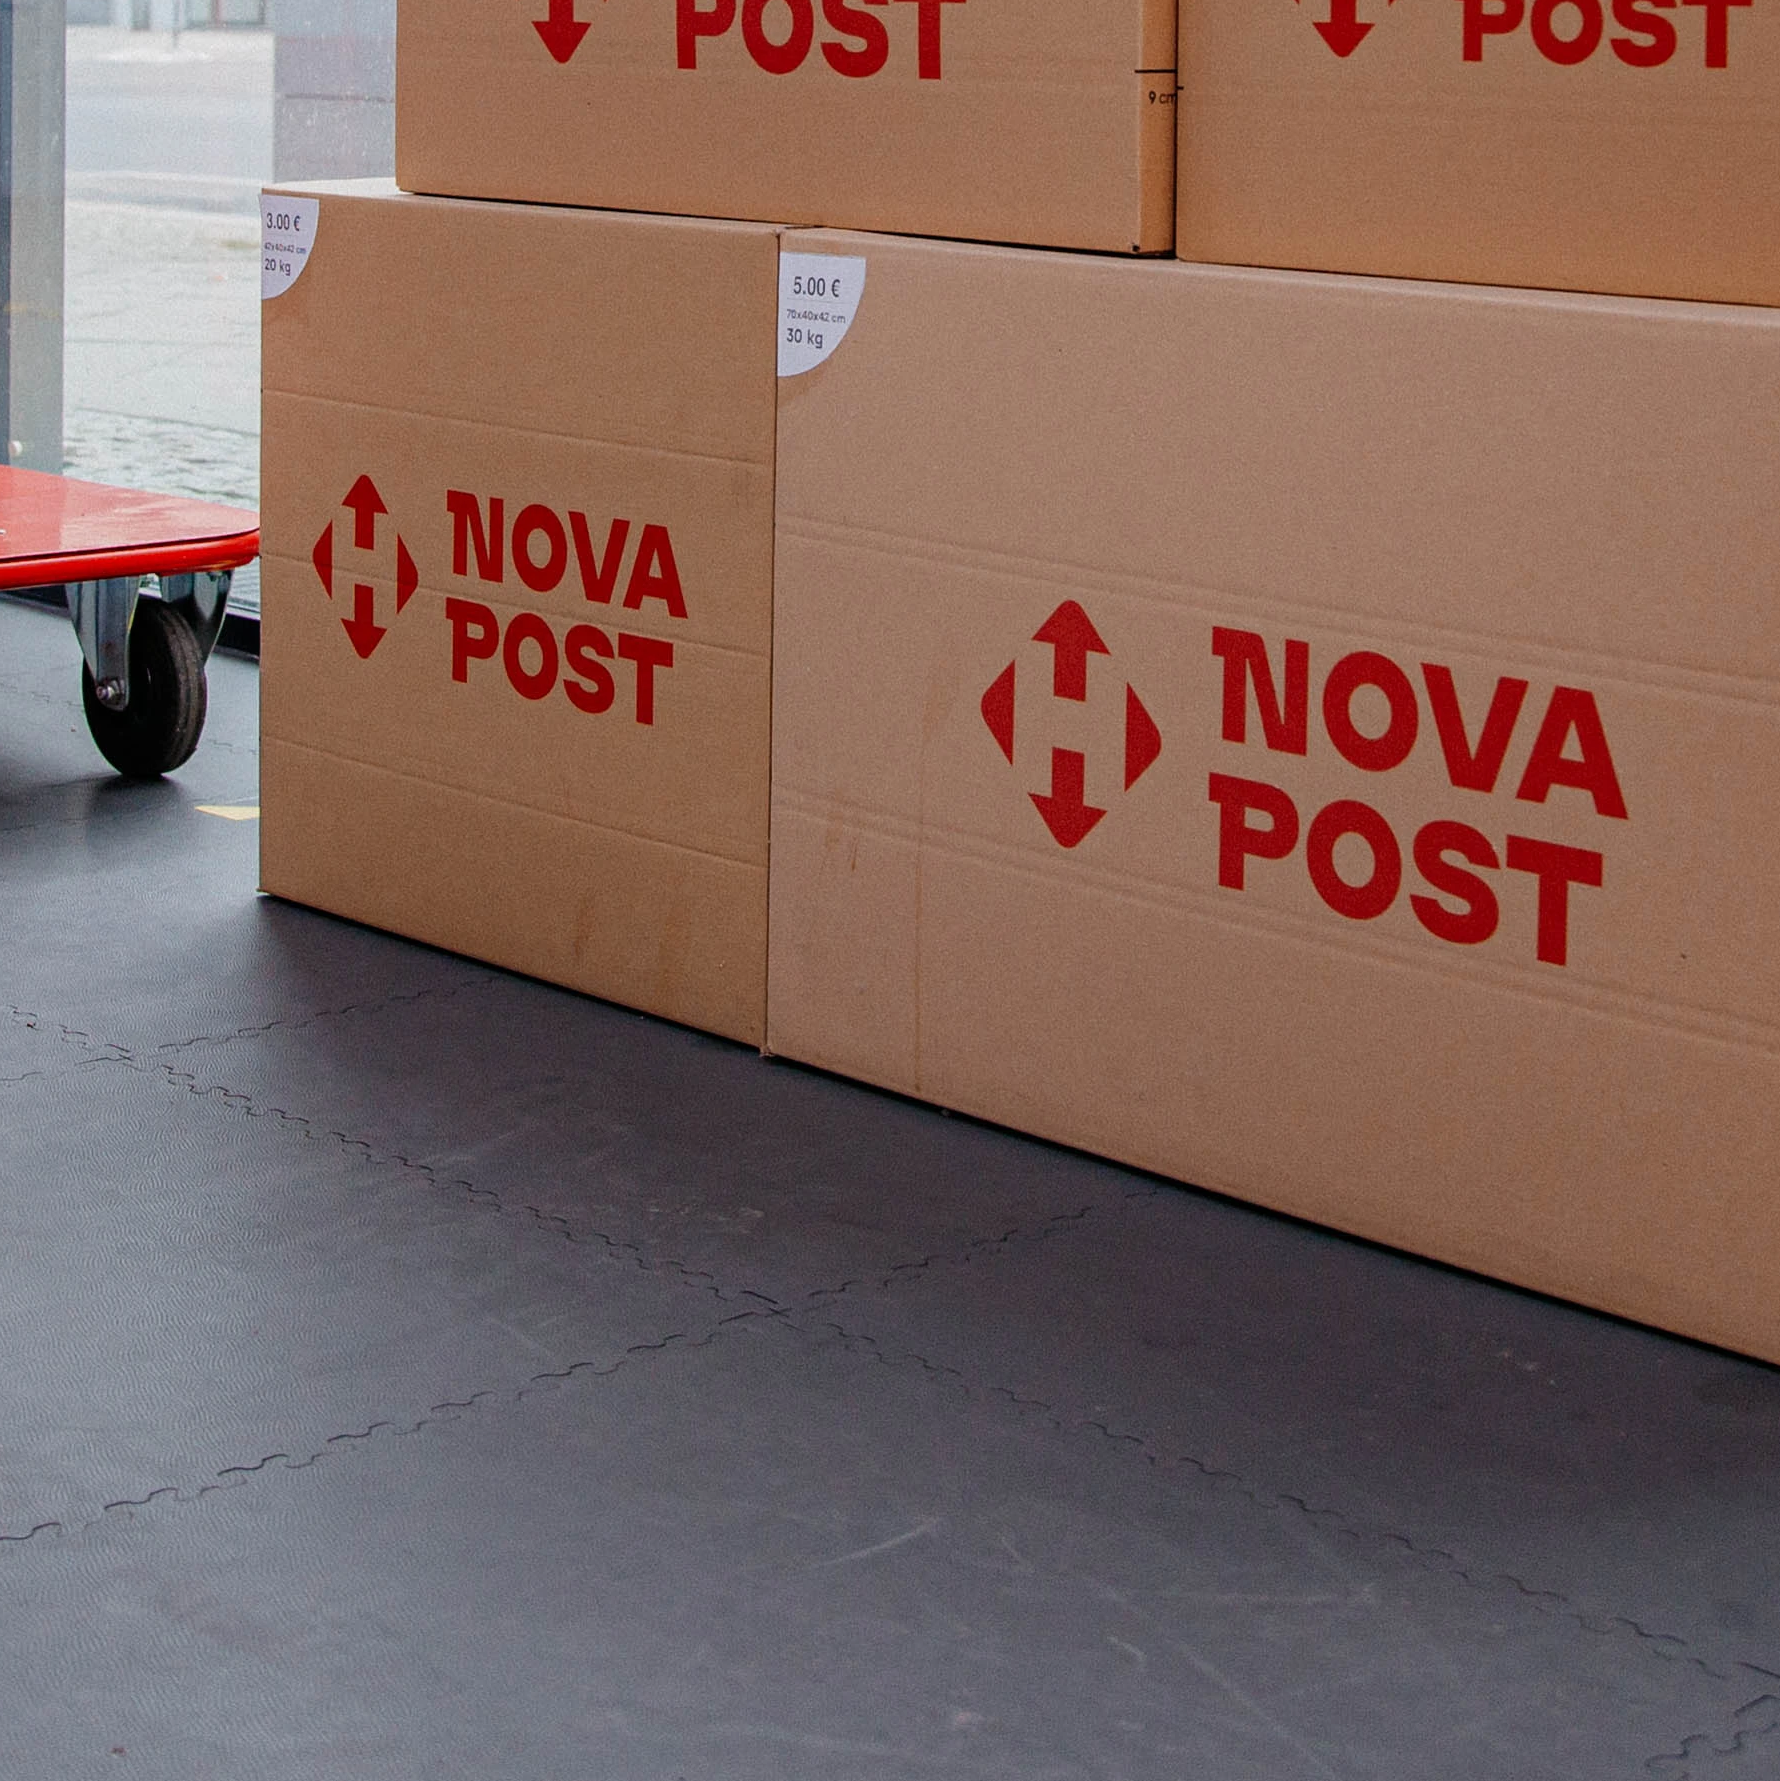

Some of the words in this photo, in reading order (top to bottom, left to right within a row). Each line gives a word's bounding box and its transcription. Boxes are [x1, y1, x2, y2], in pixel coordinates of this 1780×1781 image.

[1148, 90, 1156, 105] 9
[266, 213, 290, 231] 3.00
[294, 215, 301, 231] €
[265, 258, 276, 271] 20
[280, 260, 291, 276] kg
[793, 276, 825, 296] 5.00
[832, 279, 840, 297] €
[786, 308, 829, 322] 70x40x42
[831, 315, 846, 324] cm
[786, 328, 802, 343] 30
[807, 329, 823, 349] kg
[446, 489, 688, 618] NOVA
[445, 596, 673, 725] POST
[1213, 626, 1629, 820] NOVA
[1209, 772, 1602, 966] POST
